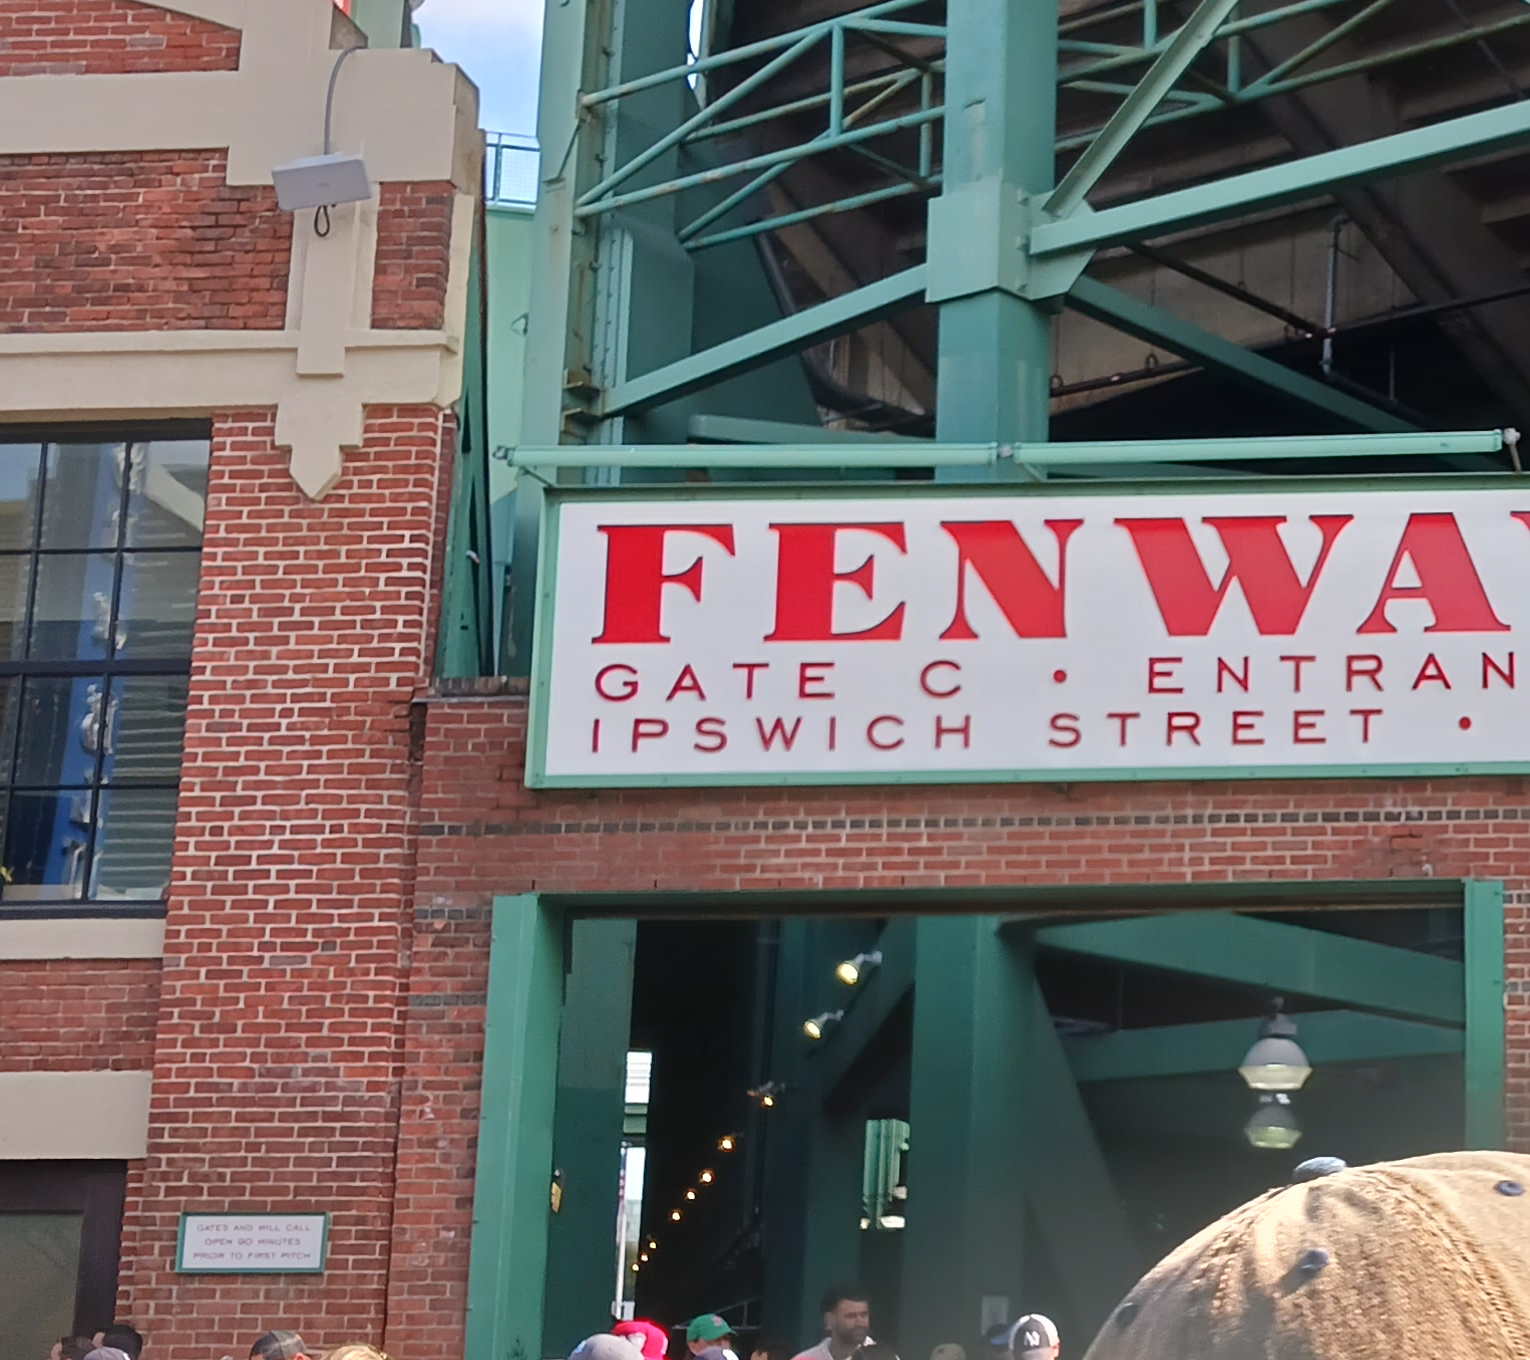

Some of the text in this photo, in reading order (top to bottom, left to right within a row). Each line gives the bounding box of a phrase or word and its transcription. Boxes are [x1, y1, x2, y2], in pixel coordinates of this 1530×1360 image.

[595, 661, 836, 704] GATE
[919, 661, 961, 699] C
[592, 712, 970, 753] IPSWICH
[1049, 707, 1383, 748] STREET
[196, 1223, 229, 1232] GATES
[233, 1223, 254, 1232] AND
[285, 1223, 312, 1232] CALL
[204, 1237, 233, 1246] OPEN
[257, 1237, 301, 1246] MINUTES
[192, 1251, 311, 1261] PRIOR TO FIRST PITCH
